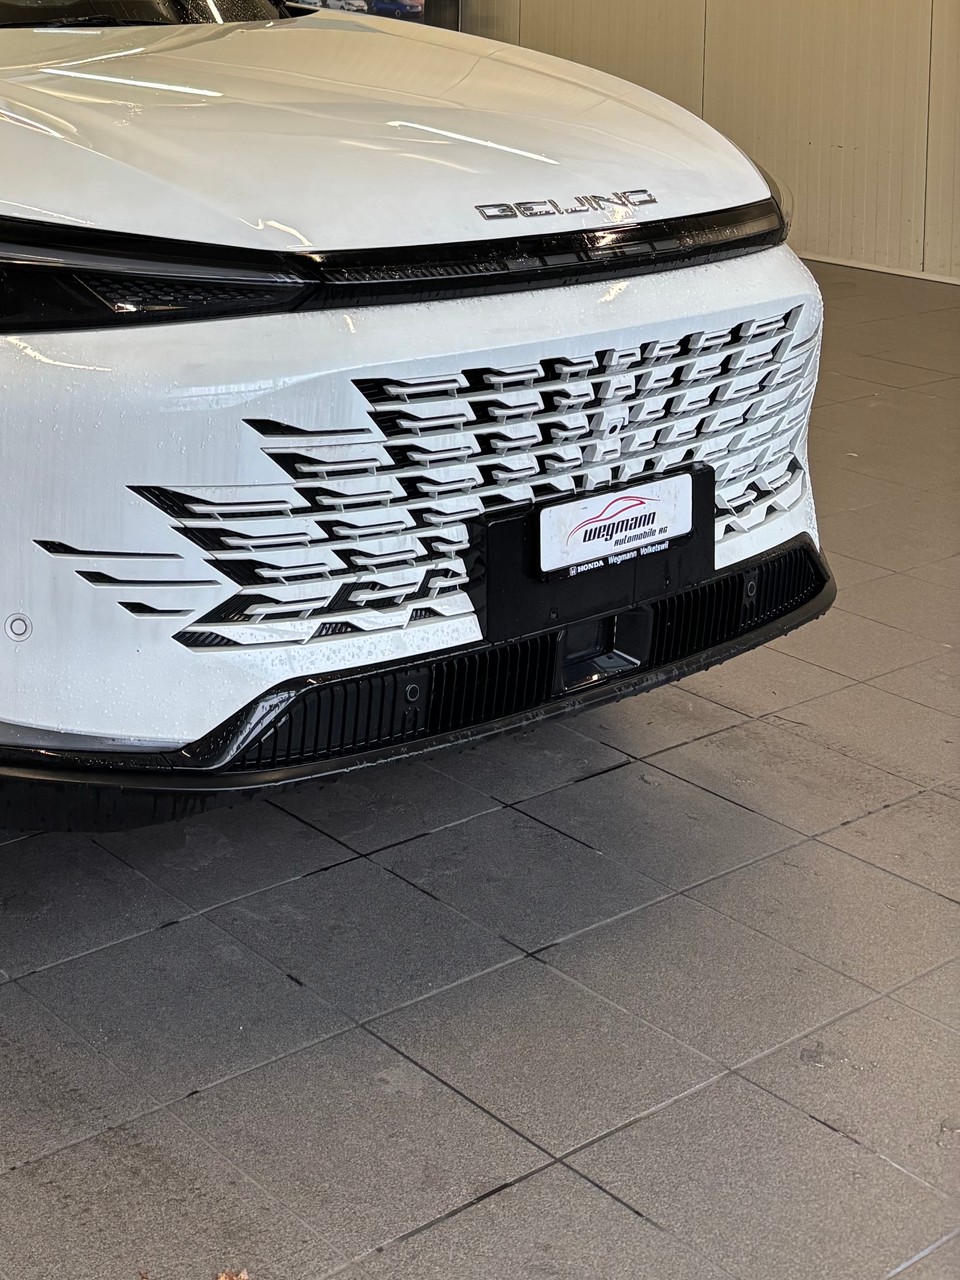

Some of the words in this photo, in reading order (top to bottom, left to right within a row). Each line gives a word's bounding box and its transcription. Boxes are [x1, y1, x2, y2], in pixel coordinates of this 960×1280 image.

[474, 189, 658, 220] BEIJING
[582, 511, 657, 542] wegmann
[577, 560, 604, 572] HONDA
[608, 550, 637, 564] Wegmann
